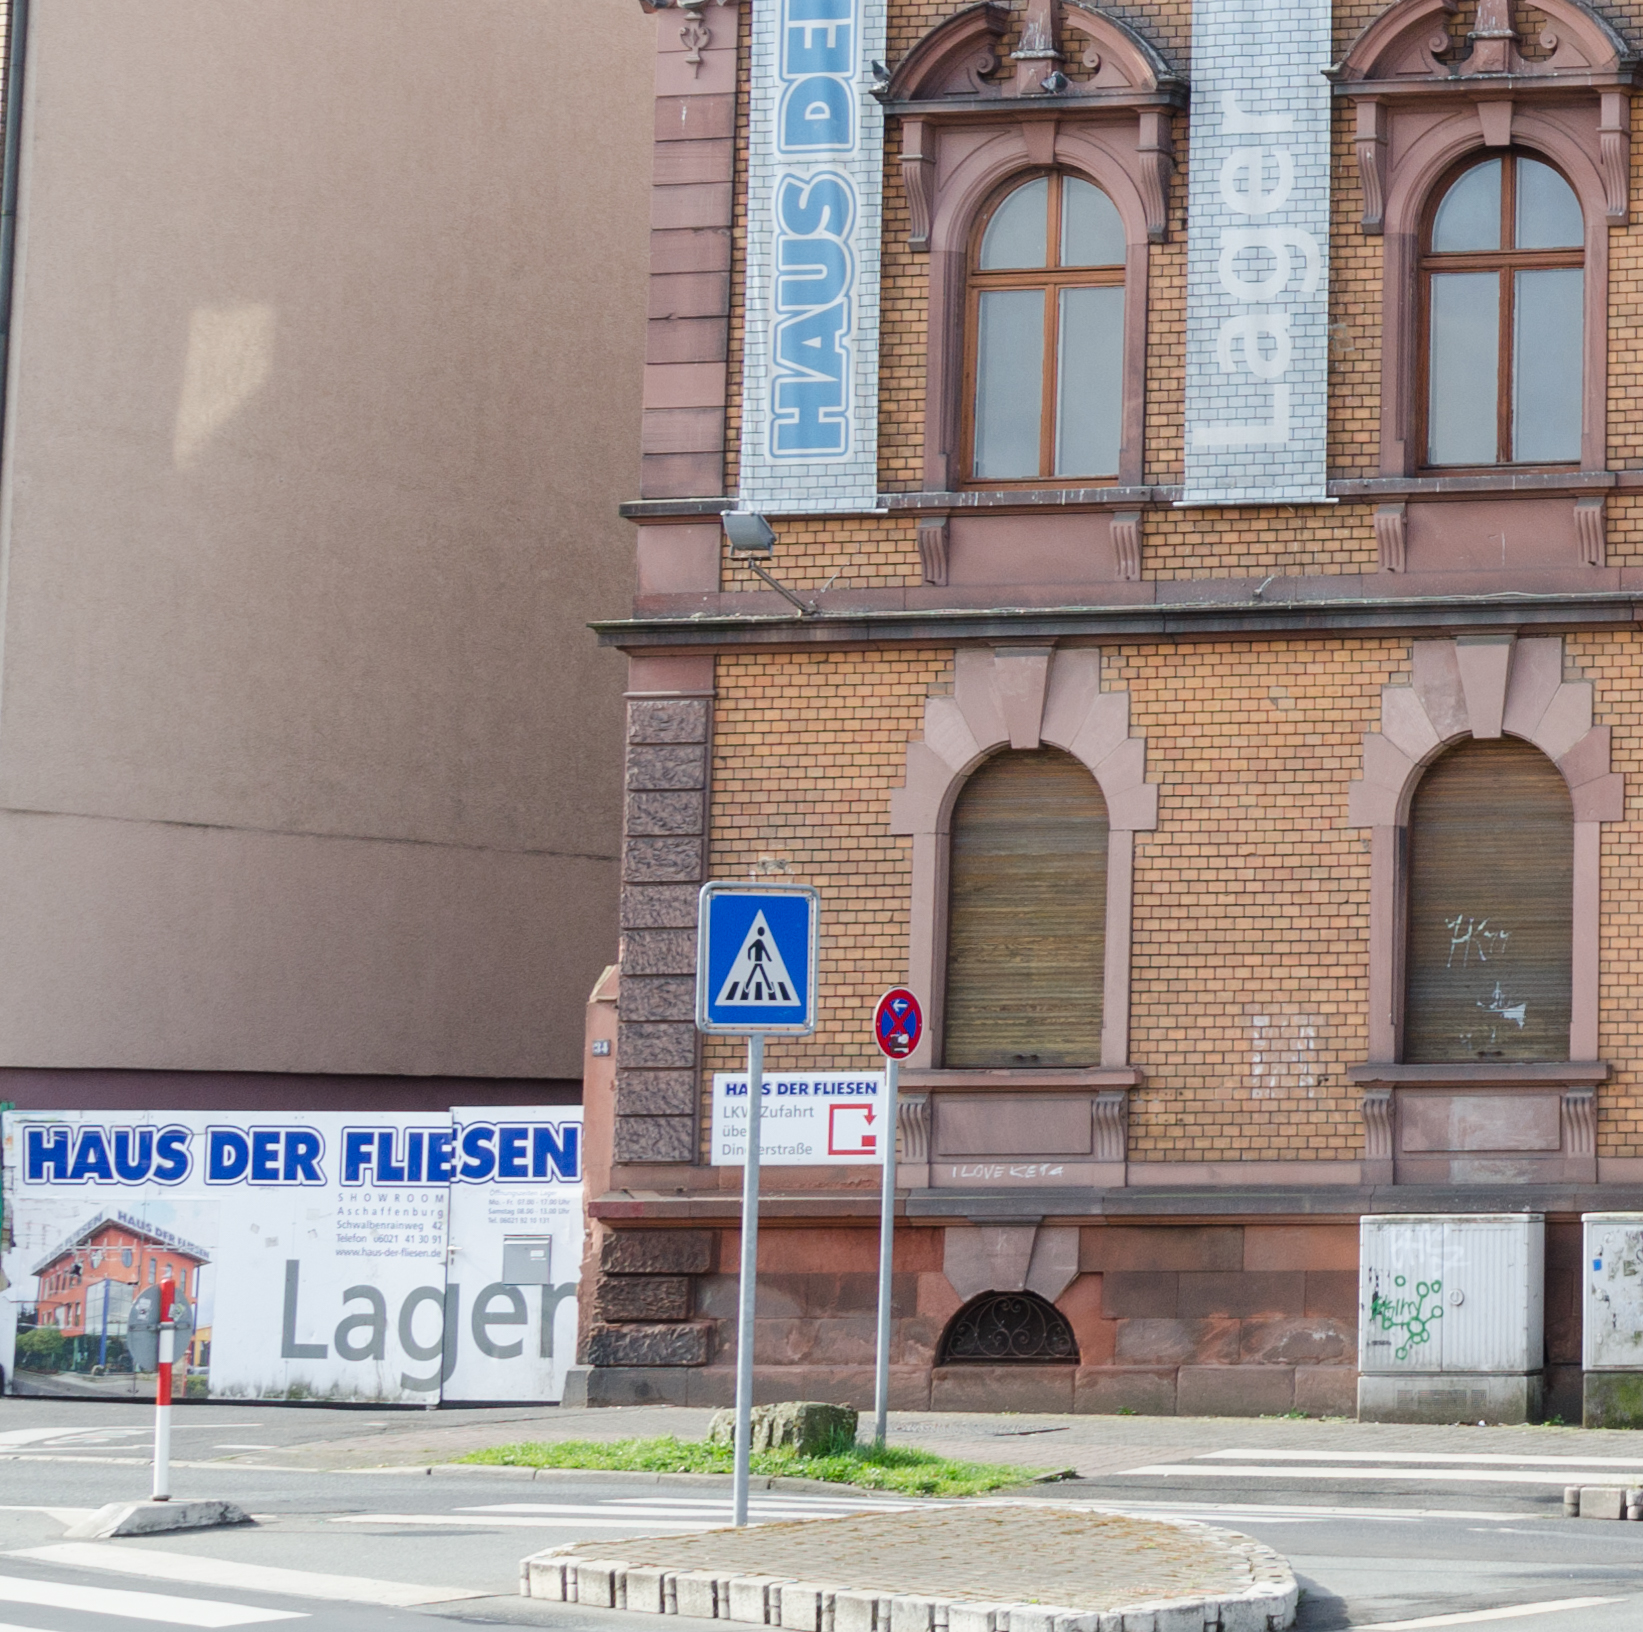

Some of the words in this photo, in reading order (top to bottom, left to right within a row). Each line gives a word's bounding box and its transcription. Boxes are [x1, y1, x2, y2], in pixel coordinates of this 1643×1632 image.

[1197, 101, 1320, 450] Lager
[769, 175, 859, 460] HAUS
[725, 1082, 771, 1096] HAS
[777, 1082, 809, 1095] DER
[813, 1081, 878, 1095] FLIESEN
[723, 1125, 748, 1137] übe
[23, 1124, 194, 1186] HAUS
[204, 1125, 327, 1186] DER
[340, 1121, 583, 1187] FLIESEN
[722, 1142, 813, 1155] Dinerstraße
[961, 1164, 1005, 1179] LOVE
[1009, 1163, 1064, 1178] KETA
[337, 1192, 444, 1203] SHOWROOM
[337, 1207, 444, 1218] Aschaffenburg
[336, 1220, 424, 1232] Schwalbenrainweg
[432, 1220, 443, 1230] 42
[336, 1234, 368, 1244] Telefon
[373, 1234, 399, 1244] 06021
[405, 1234, 415, 1244] 41
[418, 1234, 429, 1244] 30
[432, 1234, 442, 1244] 91
[335, 1247, 442, 1258] www.haus-der-fliesen.de
[280, 1258, 579, 1393] Lager
